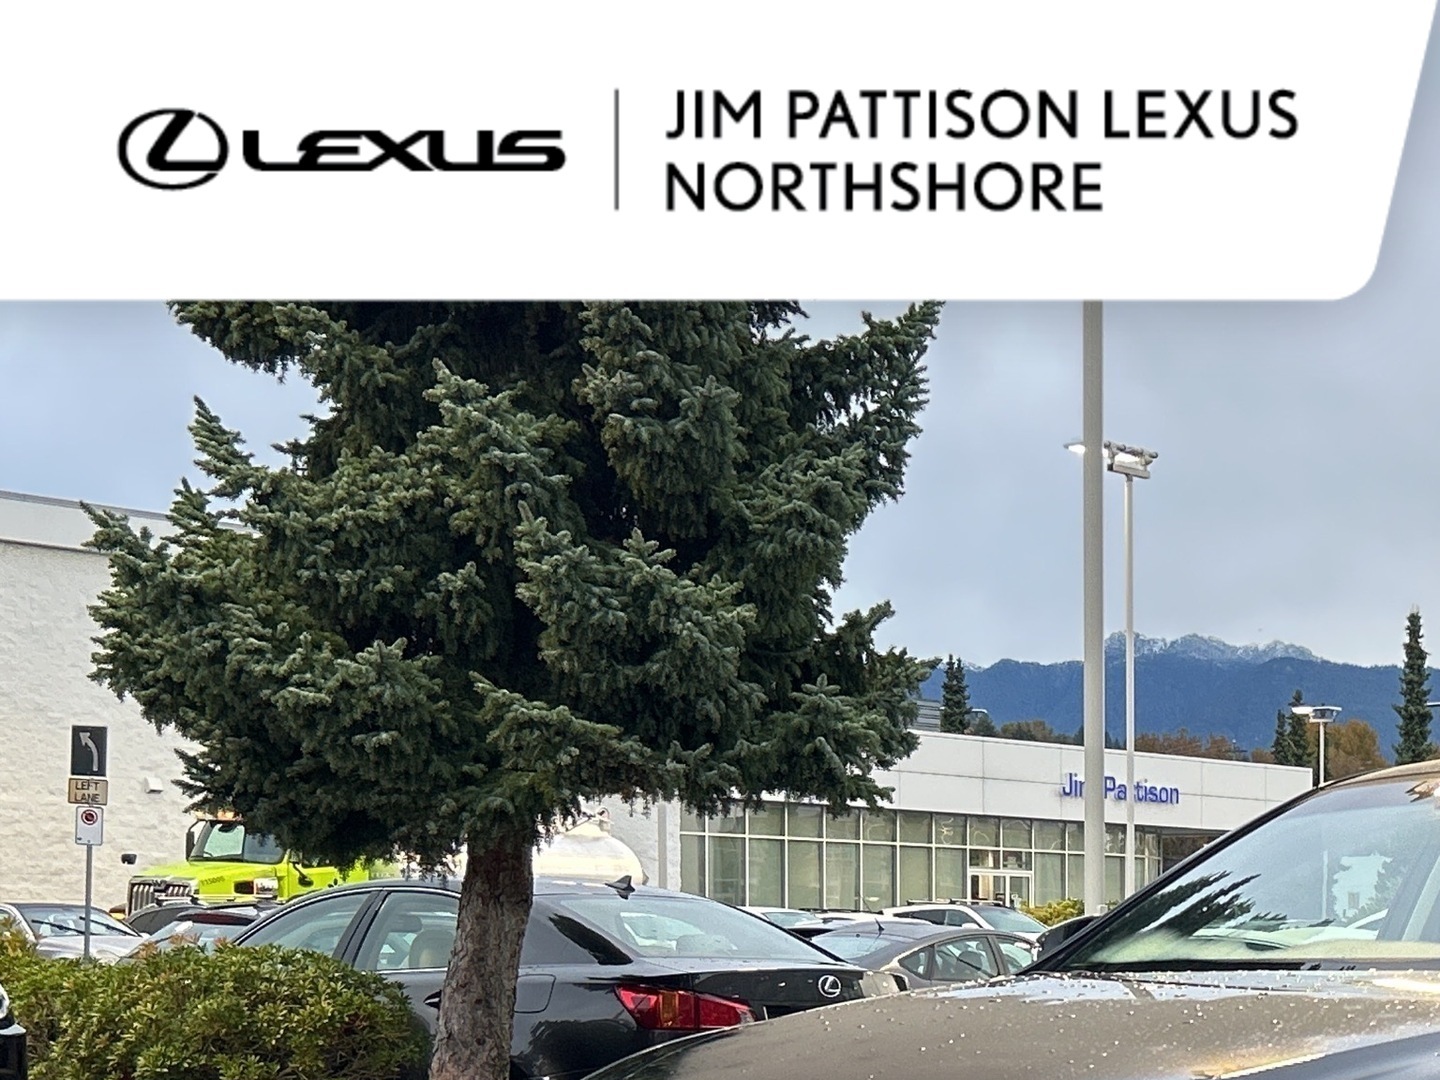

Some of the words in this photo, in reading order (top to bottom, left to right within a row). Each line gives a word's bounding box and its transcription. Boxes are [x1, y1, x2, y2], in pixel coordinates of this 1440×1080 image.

[75, 781, 100, 791] LEFT
[1104, 776, 1179, 804] Patison
[75, 792, 100, 802] LANE
